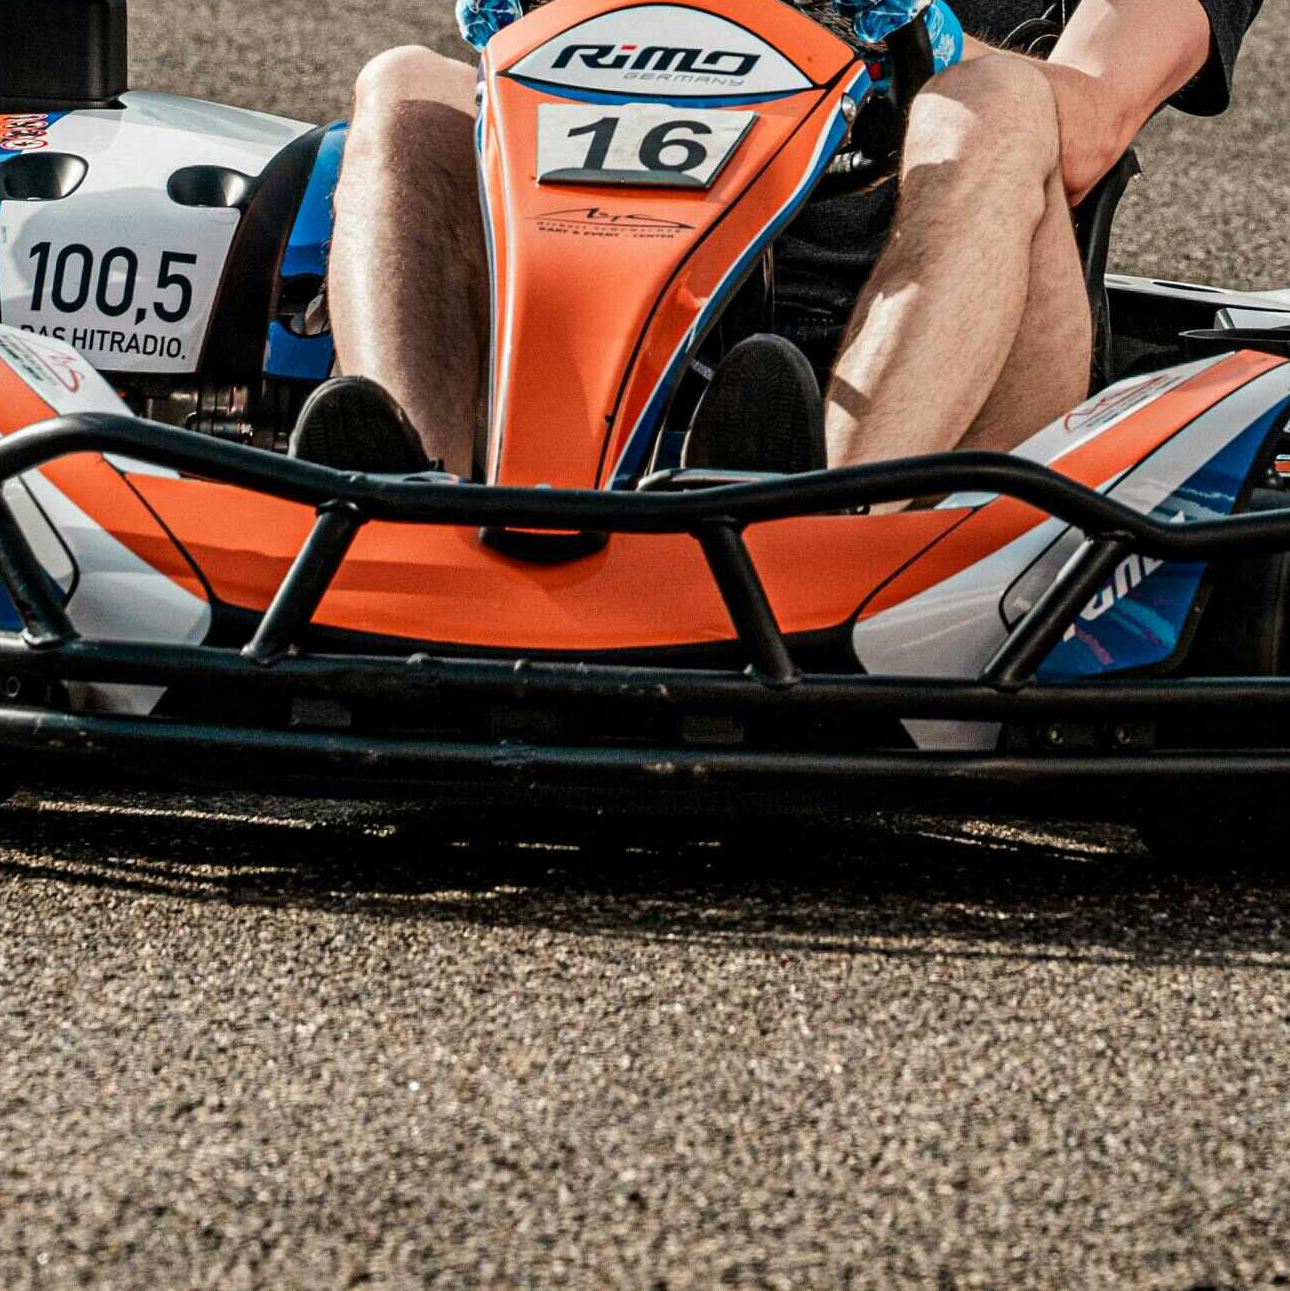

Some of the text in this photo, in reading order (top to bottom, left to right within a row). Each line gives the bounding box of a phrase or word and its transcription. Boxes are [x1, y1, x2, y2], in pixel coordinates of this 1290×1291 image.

[623, 71, 745, 87] GERMANY
[567, 116, 713, 173] 16
[29, 241, 198, 325] 100,5
[71, 327, 187, 360] HITRADIO.
